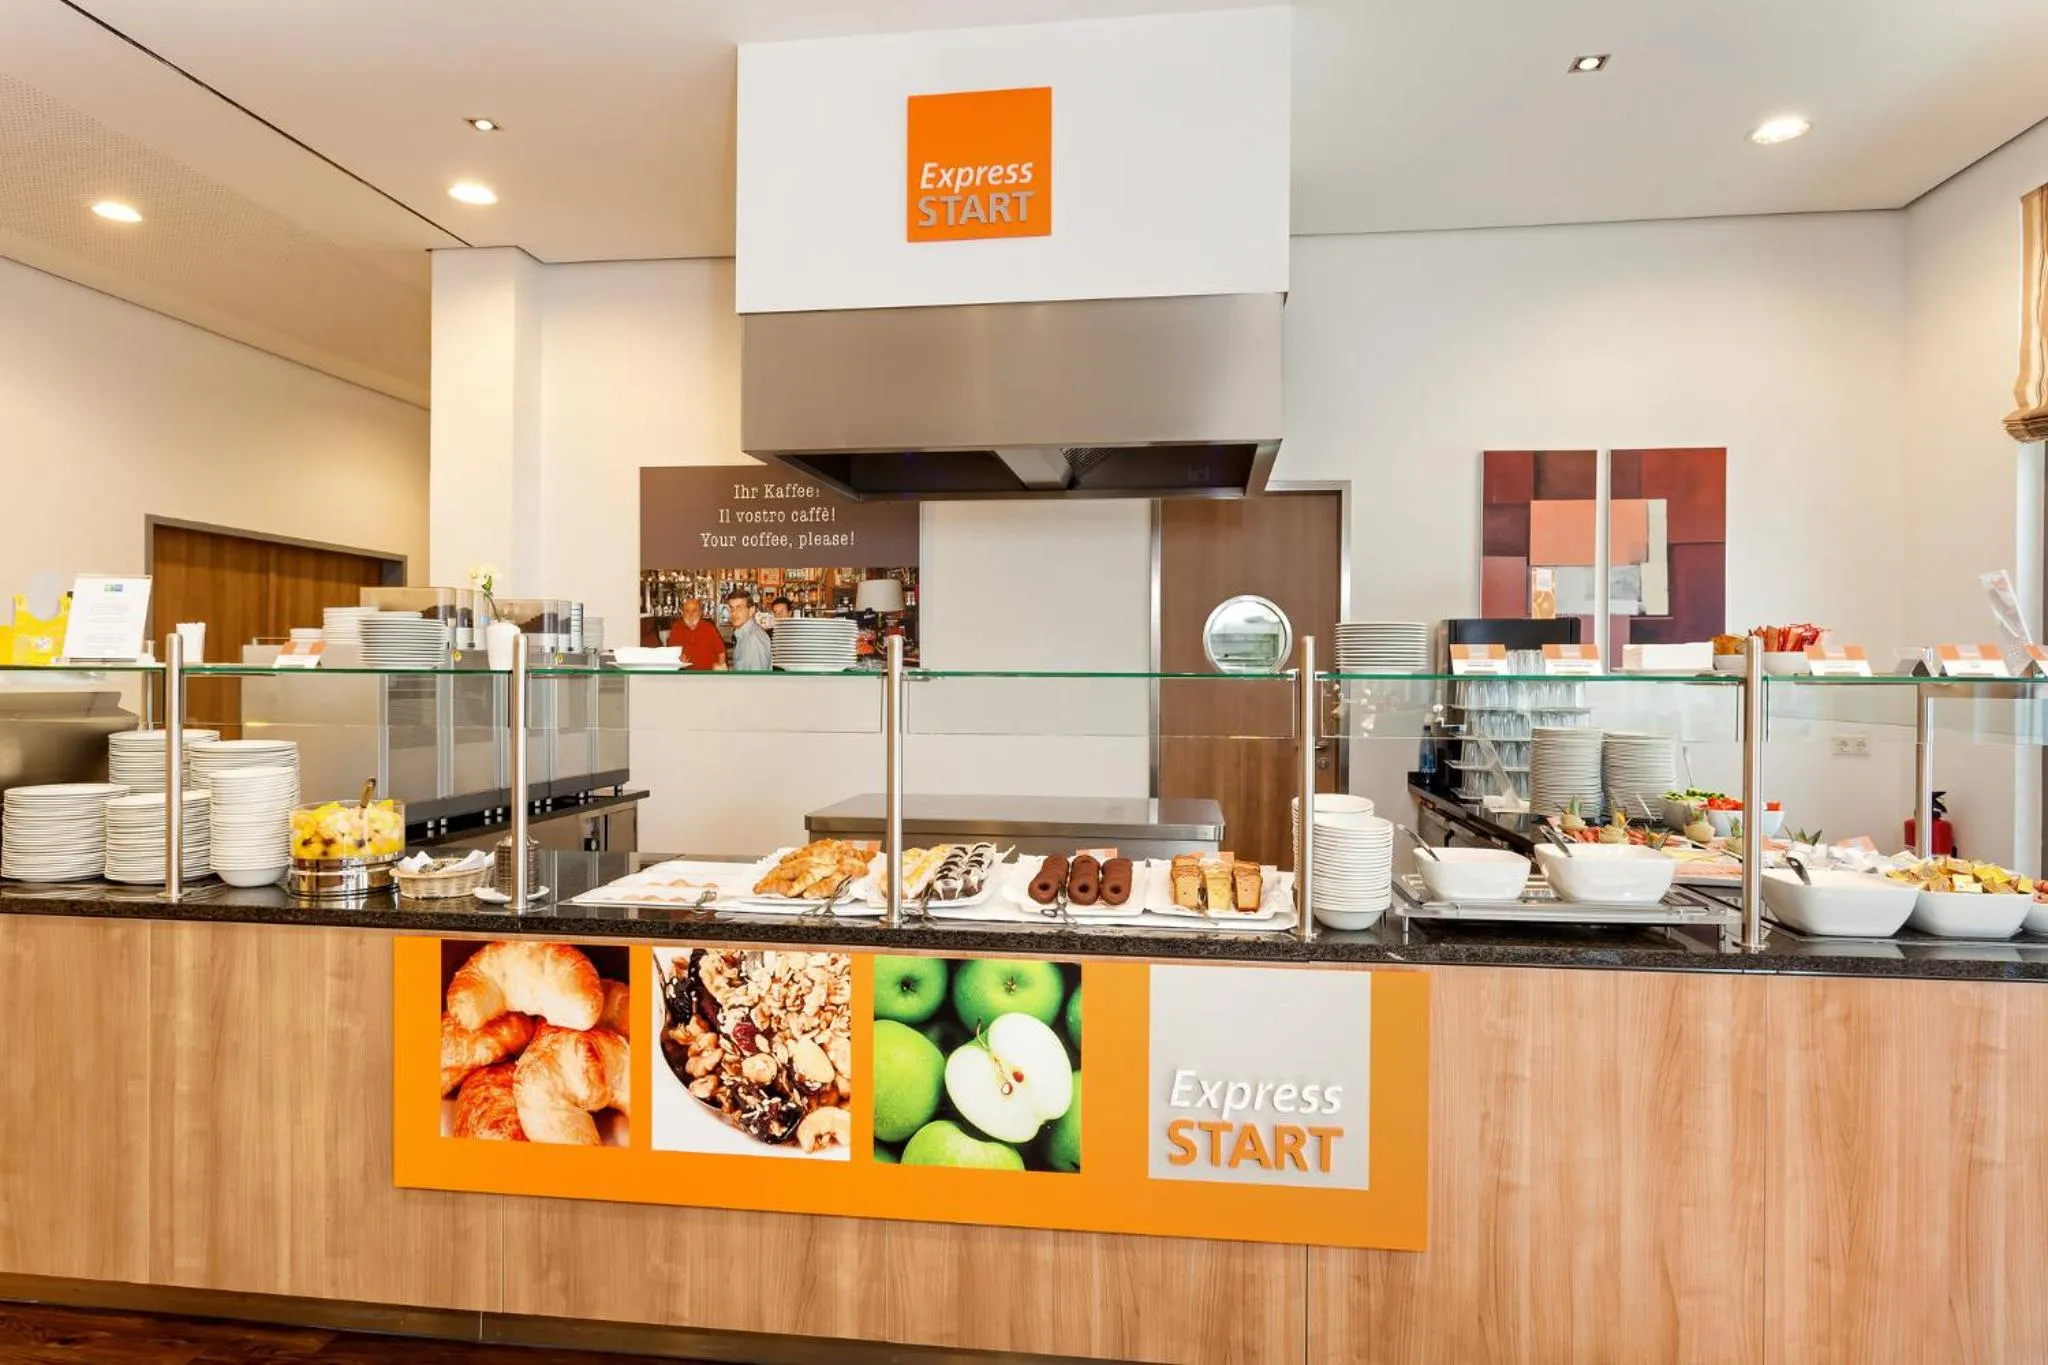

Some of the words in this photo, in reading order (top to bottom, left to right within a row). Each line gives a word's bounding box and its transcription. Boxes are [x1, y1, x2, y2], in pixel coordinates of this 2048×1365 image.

[920, 161, 1034, 194] Express
[917, 190, 1036, 226] START
[733, 484, 759, 499] Ihr
[719, 508, 731, 523] Il
[736, 508, 786, 523] vostro
[791, 506, 836, 522] caffè!
[700, 532, 737, 547] Your
[742, 531, 793, 549] coffee,
[797, 530, 855, 550] please!
[1169, 1069, 1343, 1120] Express
[1167, 1119, 1345, 1173] START
